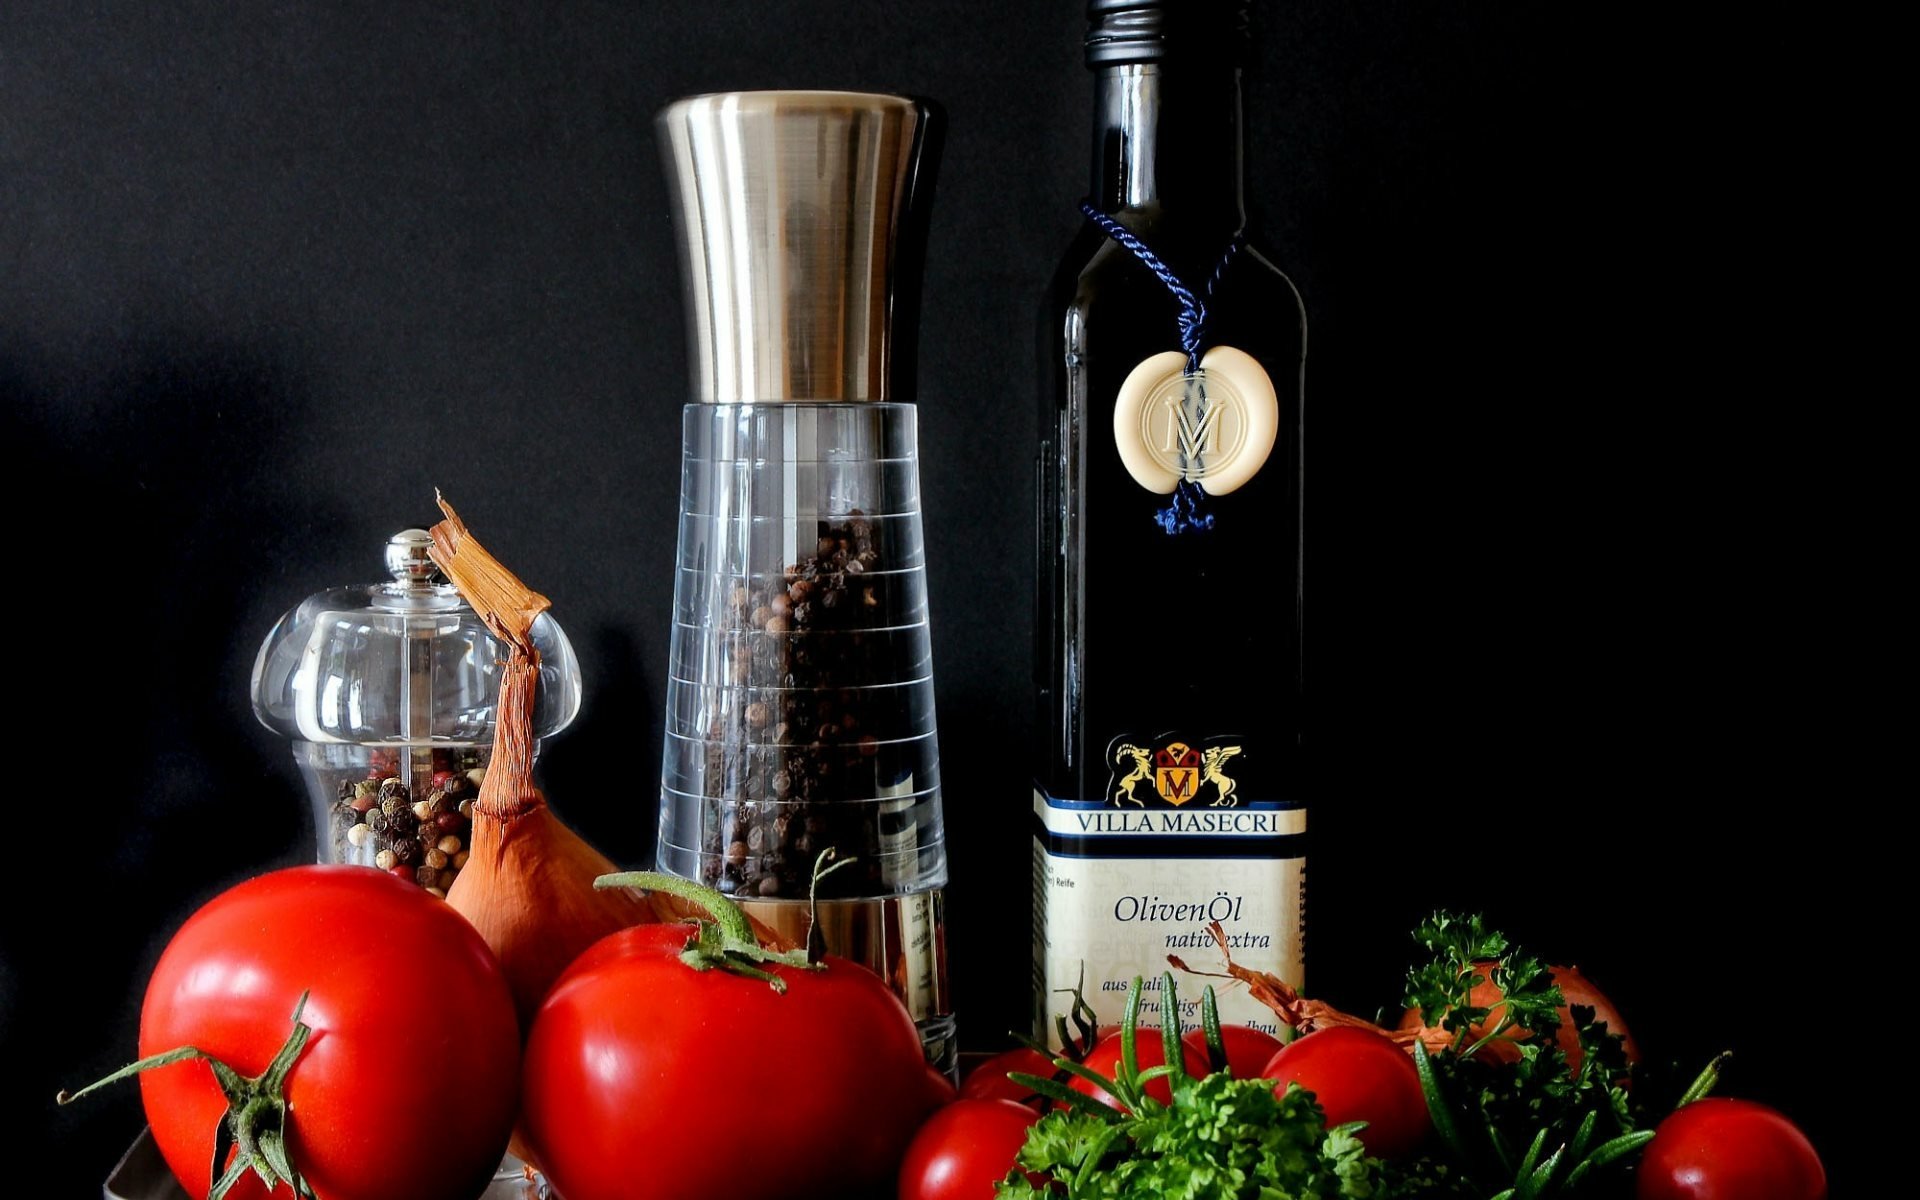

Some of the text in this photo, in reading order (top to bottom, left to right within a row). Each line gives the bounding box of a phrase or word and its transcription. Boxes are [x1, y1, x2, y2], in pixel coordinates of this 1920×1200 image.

[1076, 813, 1278, 833] VILLA MASECRI
[1114, 891, 1242, 922] OlivenÖl
[1165, 930, 1216, 948] nativ
[1102, 981, 1128, 991] aus
[1137, 998, 1195, 1017] frutig
